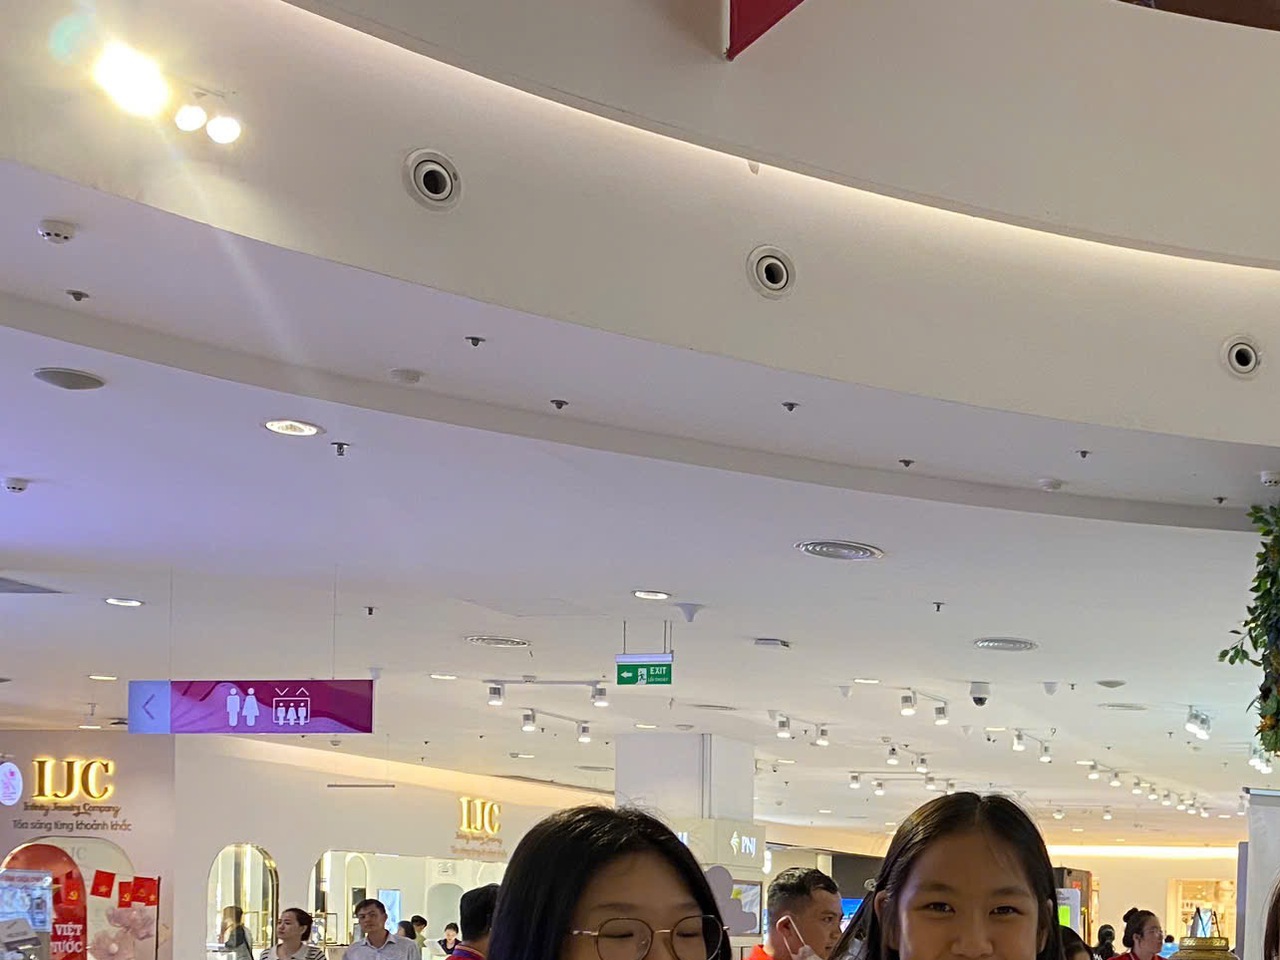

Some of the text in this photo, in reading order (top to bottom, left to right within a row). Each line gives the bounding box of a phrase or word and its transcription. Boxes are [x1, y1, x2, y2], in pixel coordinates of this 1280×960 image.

[650, 666, 667, 675] EXIT
[31, 758, 112, 800] IJC
[459, 796, 502, 835] IJC
[741, 836, 757, 858] PNJ
